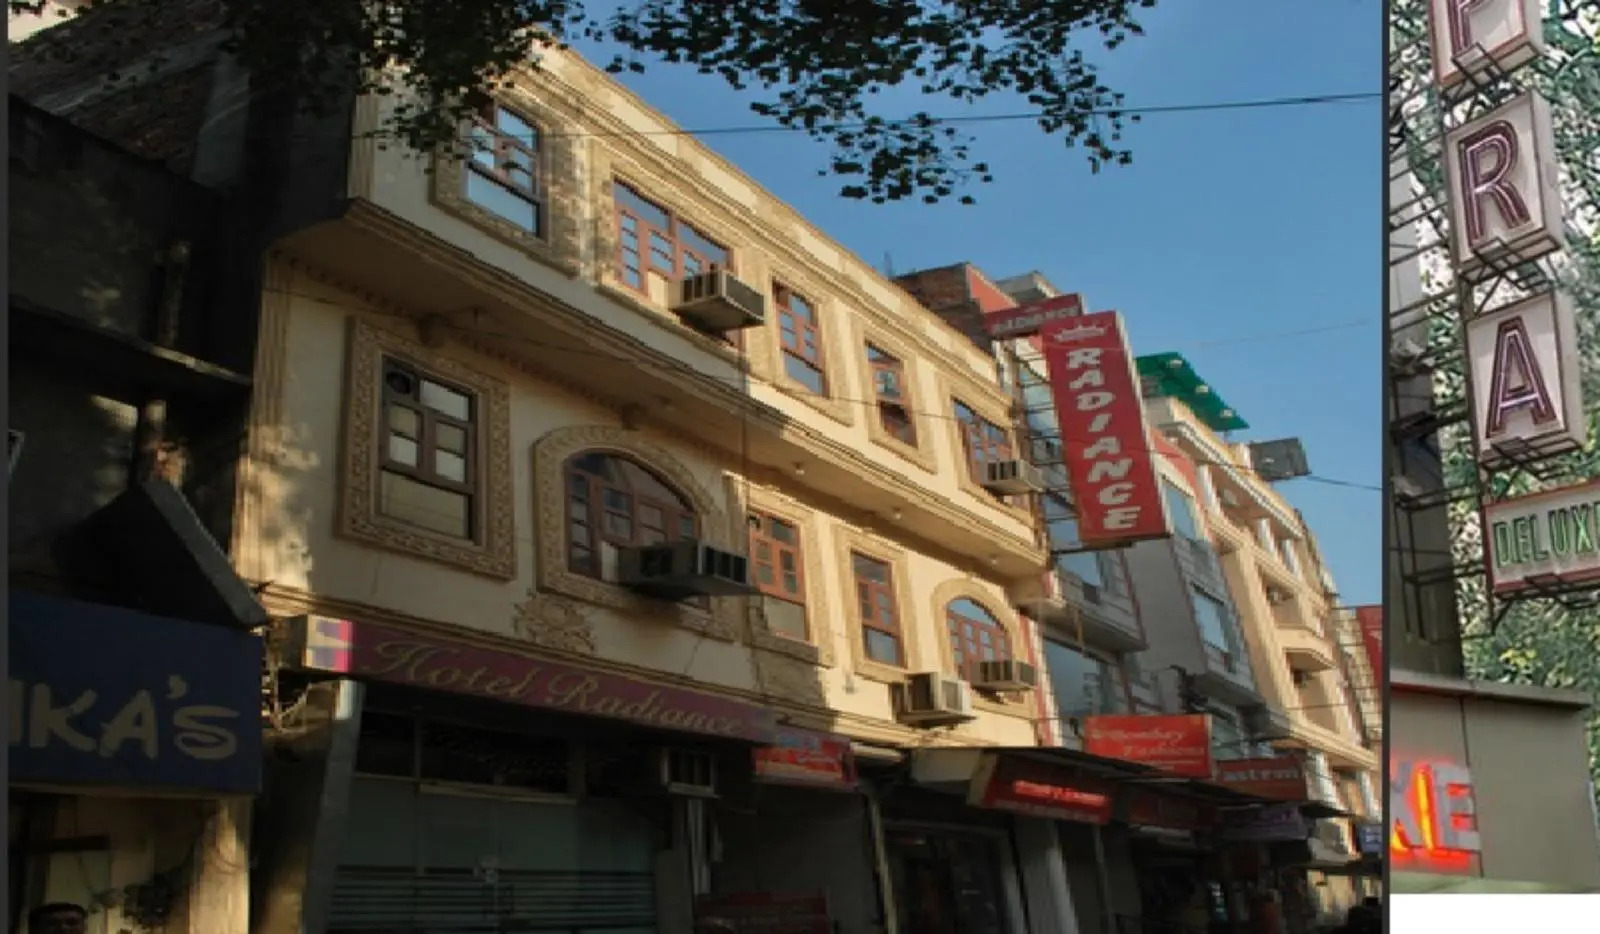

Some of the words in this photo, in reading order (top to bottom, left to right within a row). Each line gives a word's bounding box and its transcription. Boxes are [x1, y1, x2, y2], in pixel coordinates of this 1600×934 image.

[1065, 346, 1142, 530] RADIANCE
[360, 641, 543, 699] Hotel
[544, 670, 747, 734] Radiance
